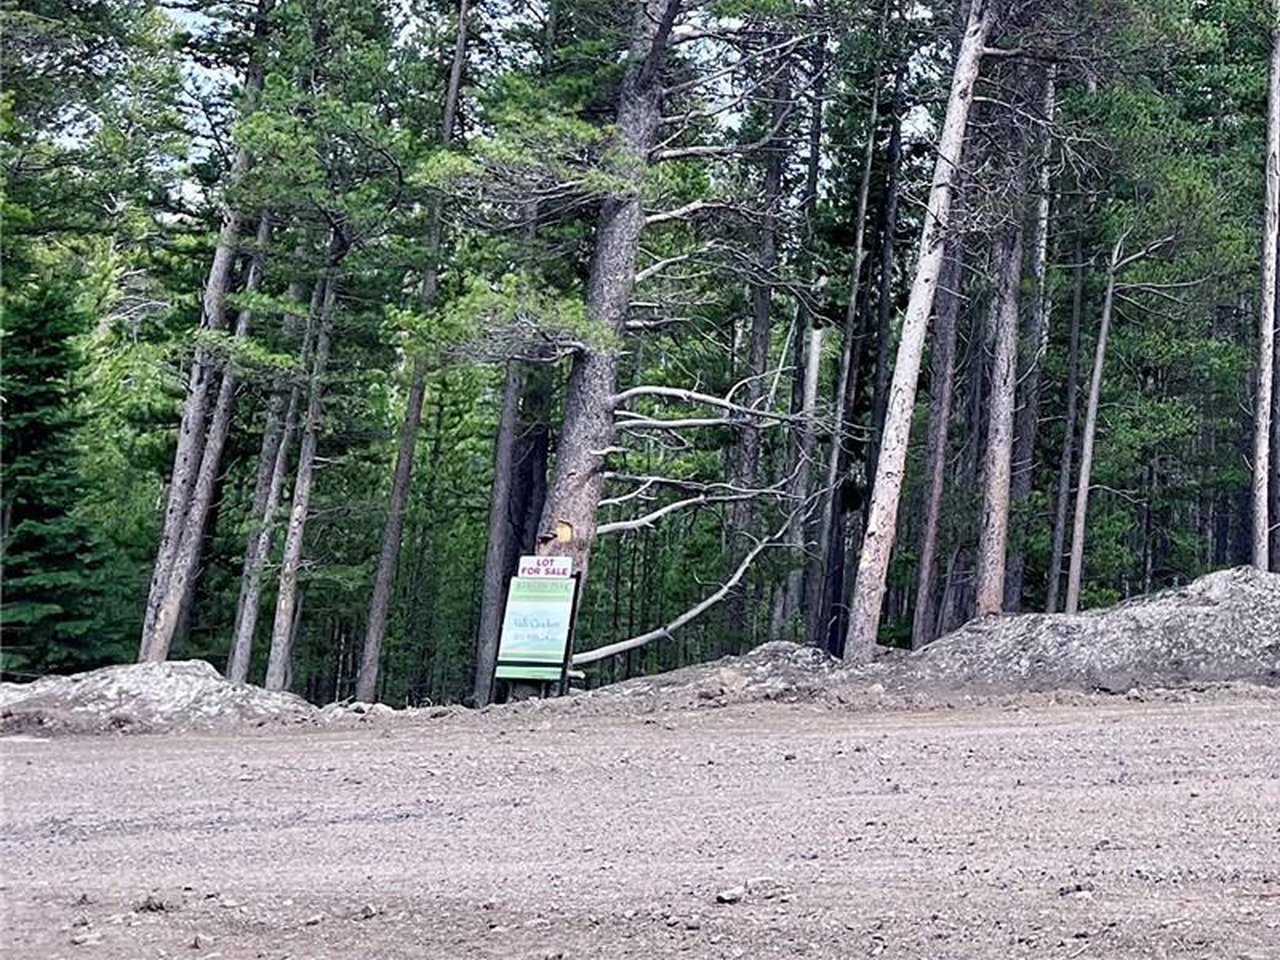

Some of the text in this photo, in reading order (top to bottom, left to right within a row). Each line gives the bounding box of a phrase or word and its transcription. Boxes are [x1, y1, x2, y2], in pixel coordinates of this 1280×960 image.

[536, 558, 554, 567] LOT
[521, 567, 569, 576] FOR SALE
